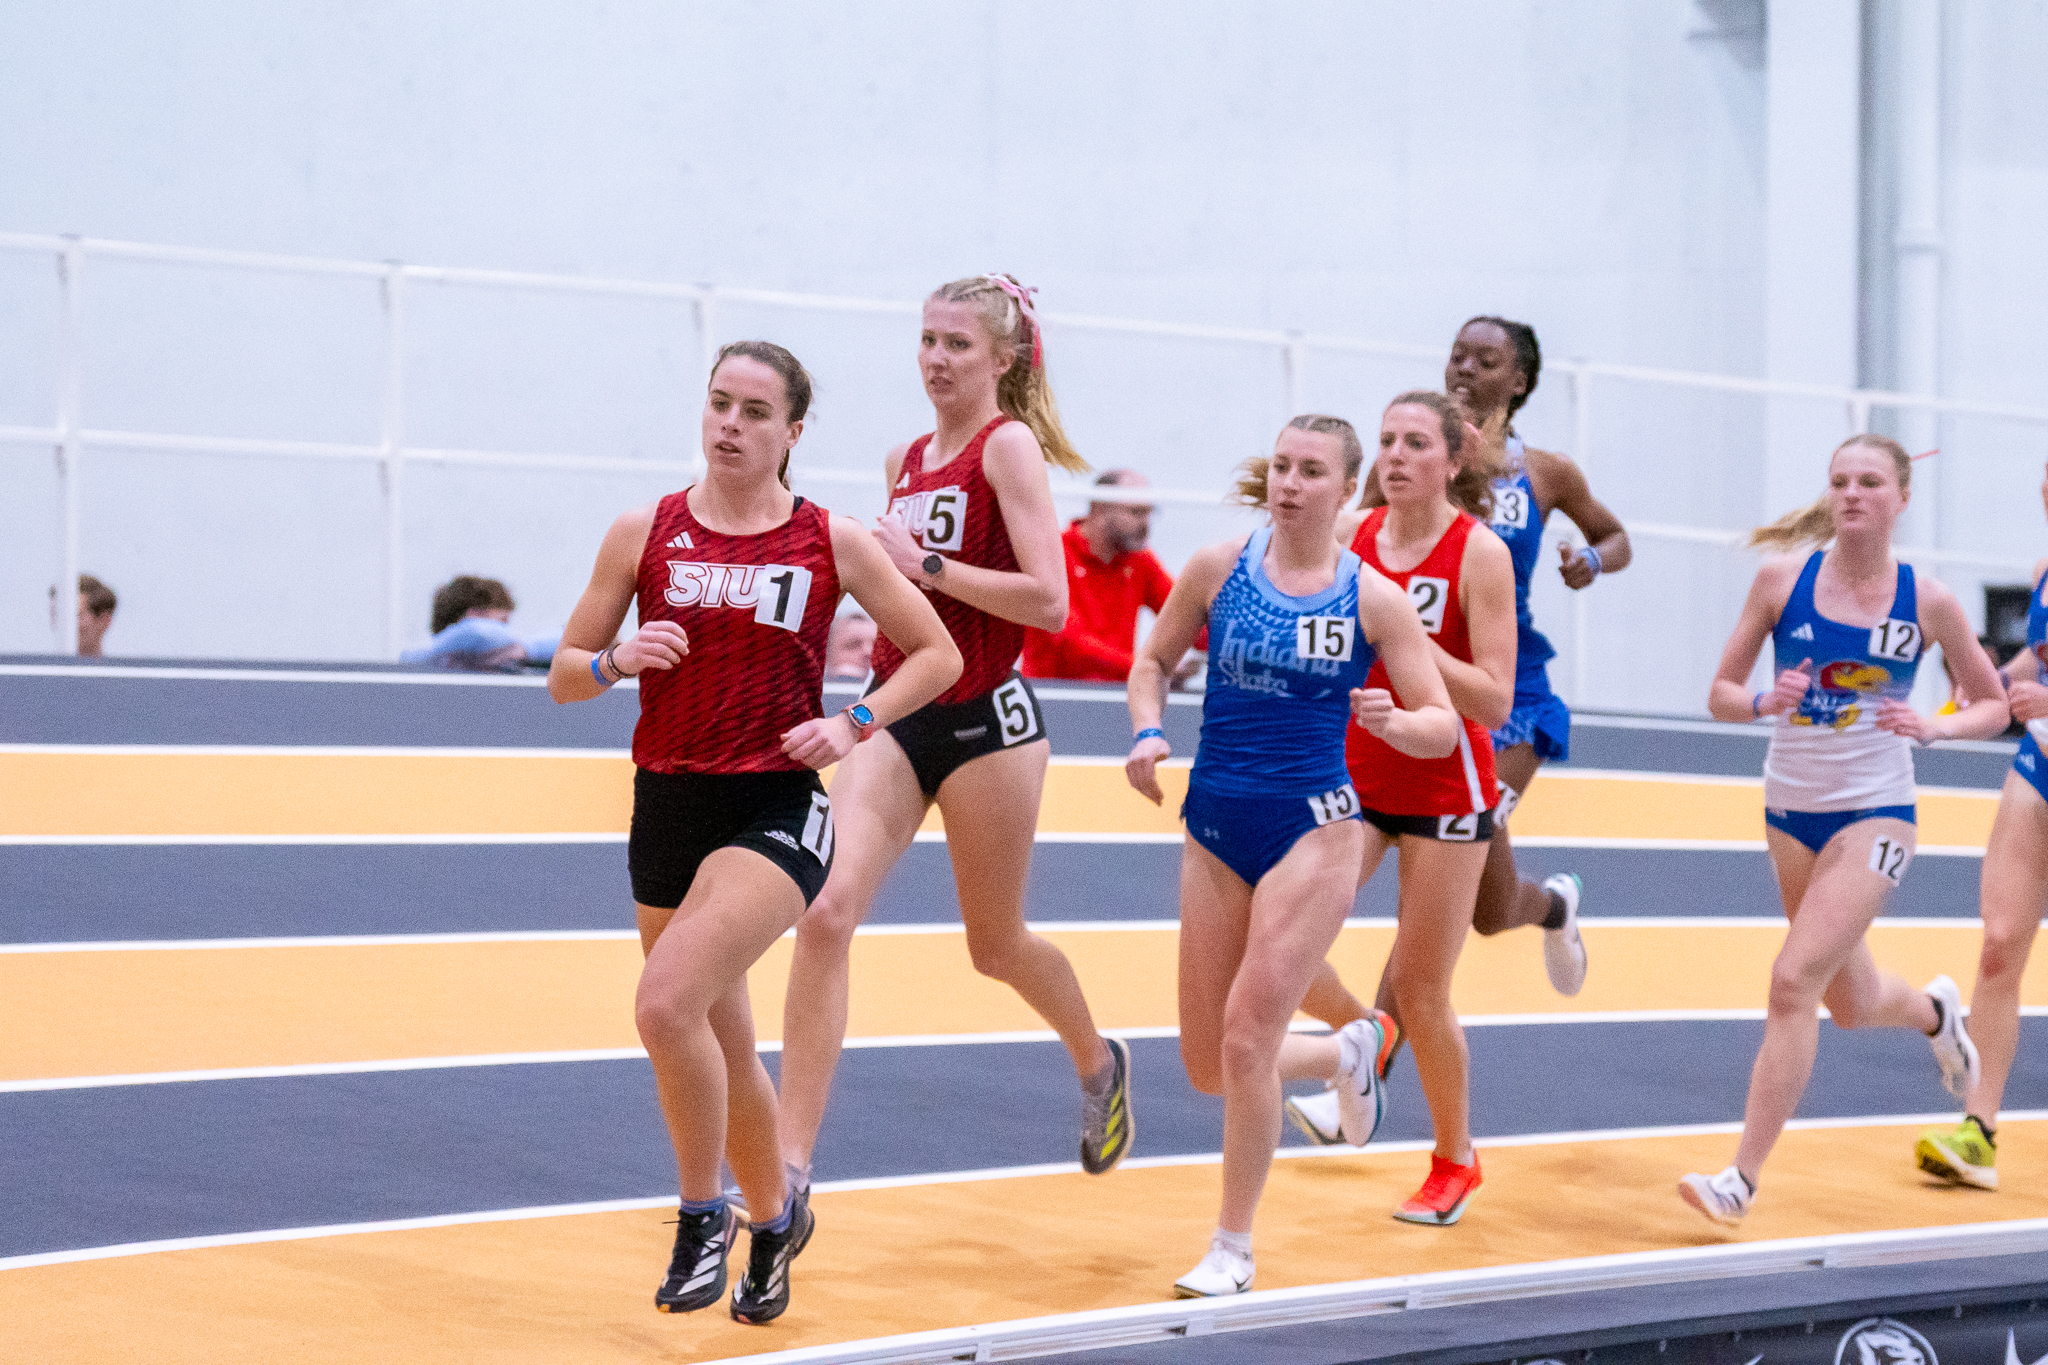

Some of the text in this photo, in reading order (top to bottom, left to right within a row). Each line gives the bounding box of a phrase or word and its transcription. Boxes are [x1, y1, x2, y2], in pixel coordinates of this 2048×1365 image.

[927, 495, 957, 544] 5
[664, 561, 768, 608] SIU
[770, 571, 794, 623] 1
[1413, 582, 1439, 627] 2
[1303, 619, 1345, 657] 15
[1879, 622, 1914, 657] 12
[999, 686, 1029, 737] 5
[815, 804, 830, 854] 1
[1879, 840, 1905, 880] 12
